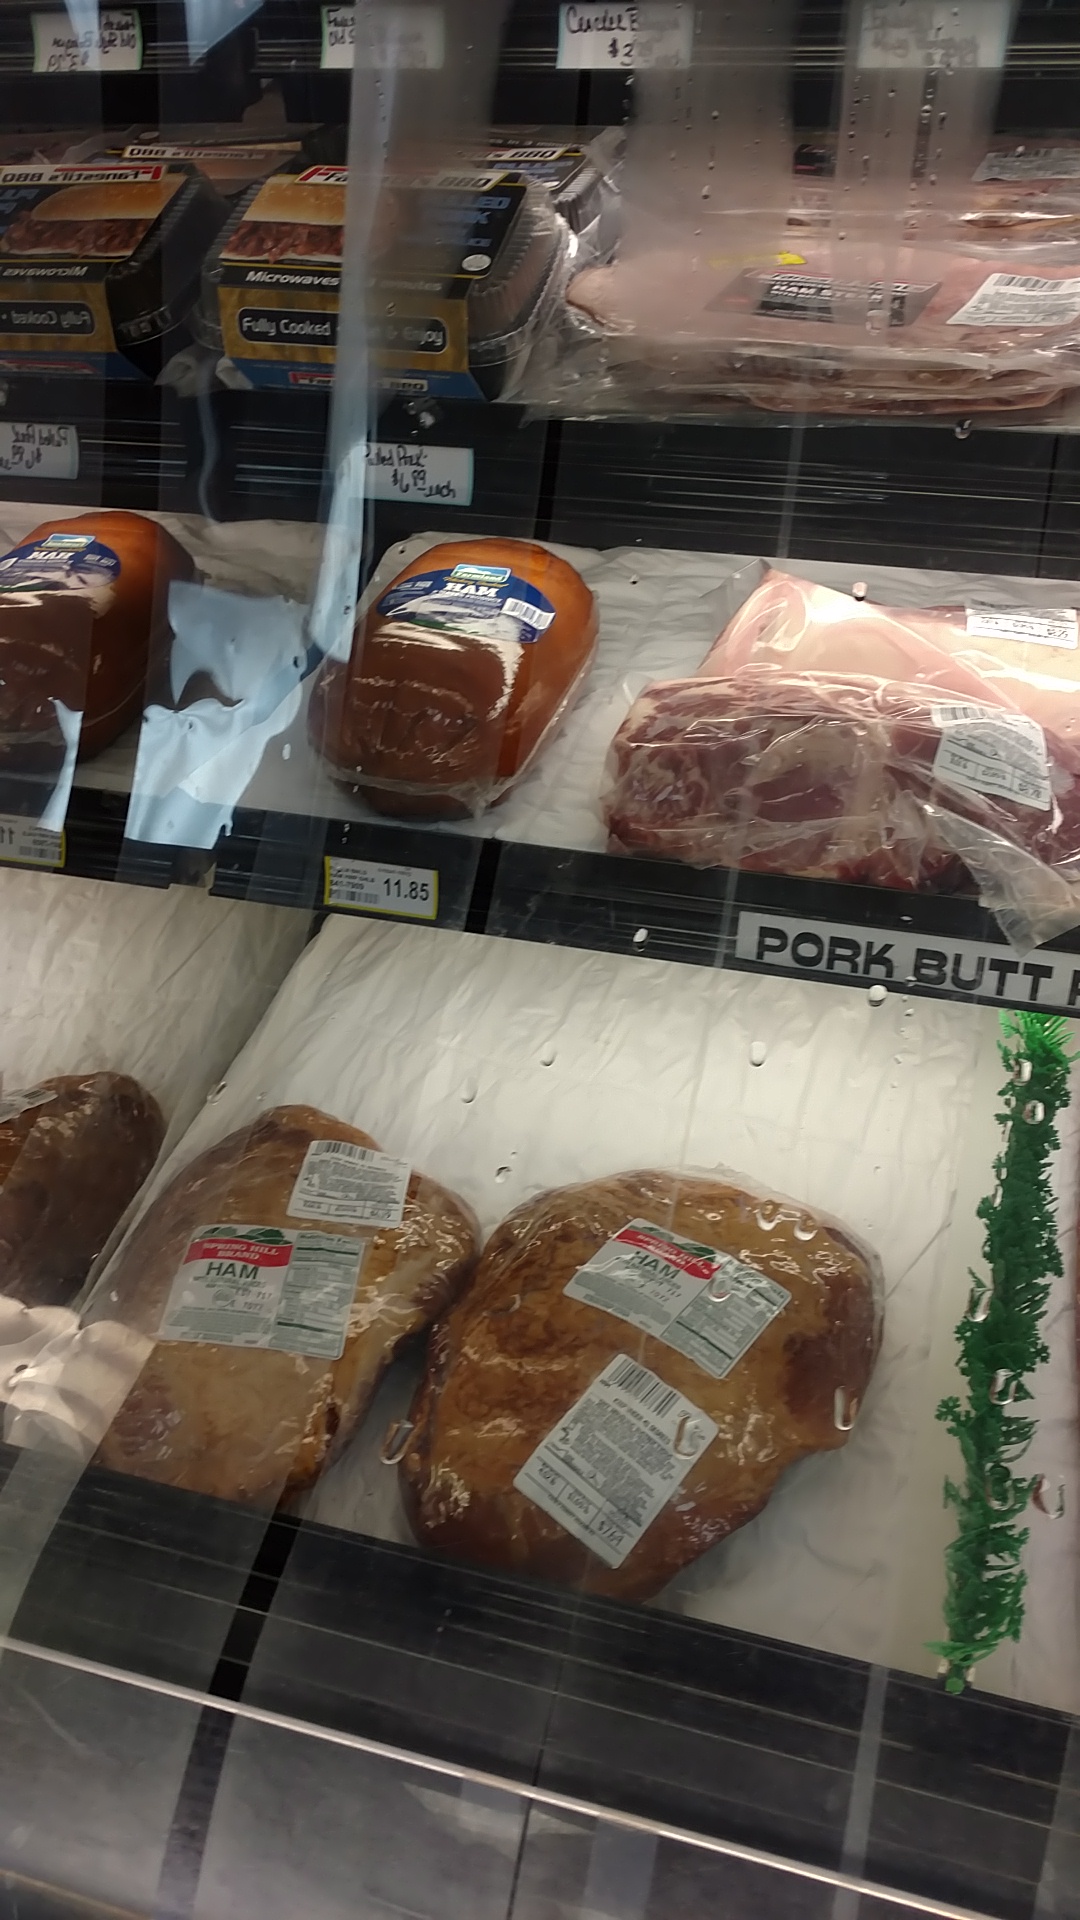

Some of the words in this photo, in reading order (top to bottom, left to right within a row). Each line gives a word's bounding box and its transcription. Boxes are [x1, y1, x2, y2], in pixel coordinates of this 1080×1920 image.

[438, 176, 491, 188] BBQ
[245, 270, 340, 287] Microwaves
[242, 317, 277, 336] Fully
[279, 319, 331, 336] Cooked
[443, 582, 500, 598] HAM
[383, 877, 429, 901] 11.85
[755, 925, 896, 979] PORK
[912, 947, 1055, 1002] BUTT
[202, 1242, 247, 1252] SPRING
[249, 1244, 280, 1256] HILL
[217, 1249, 260, 1260] BRAND
[206, 1261, 260, 1281] HAM
[631, 1251, 681, 1280] HAM
